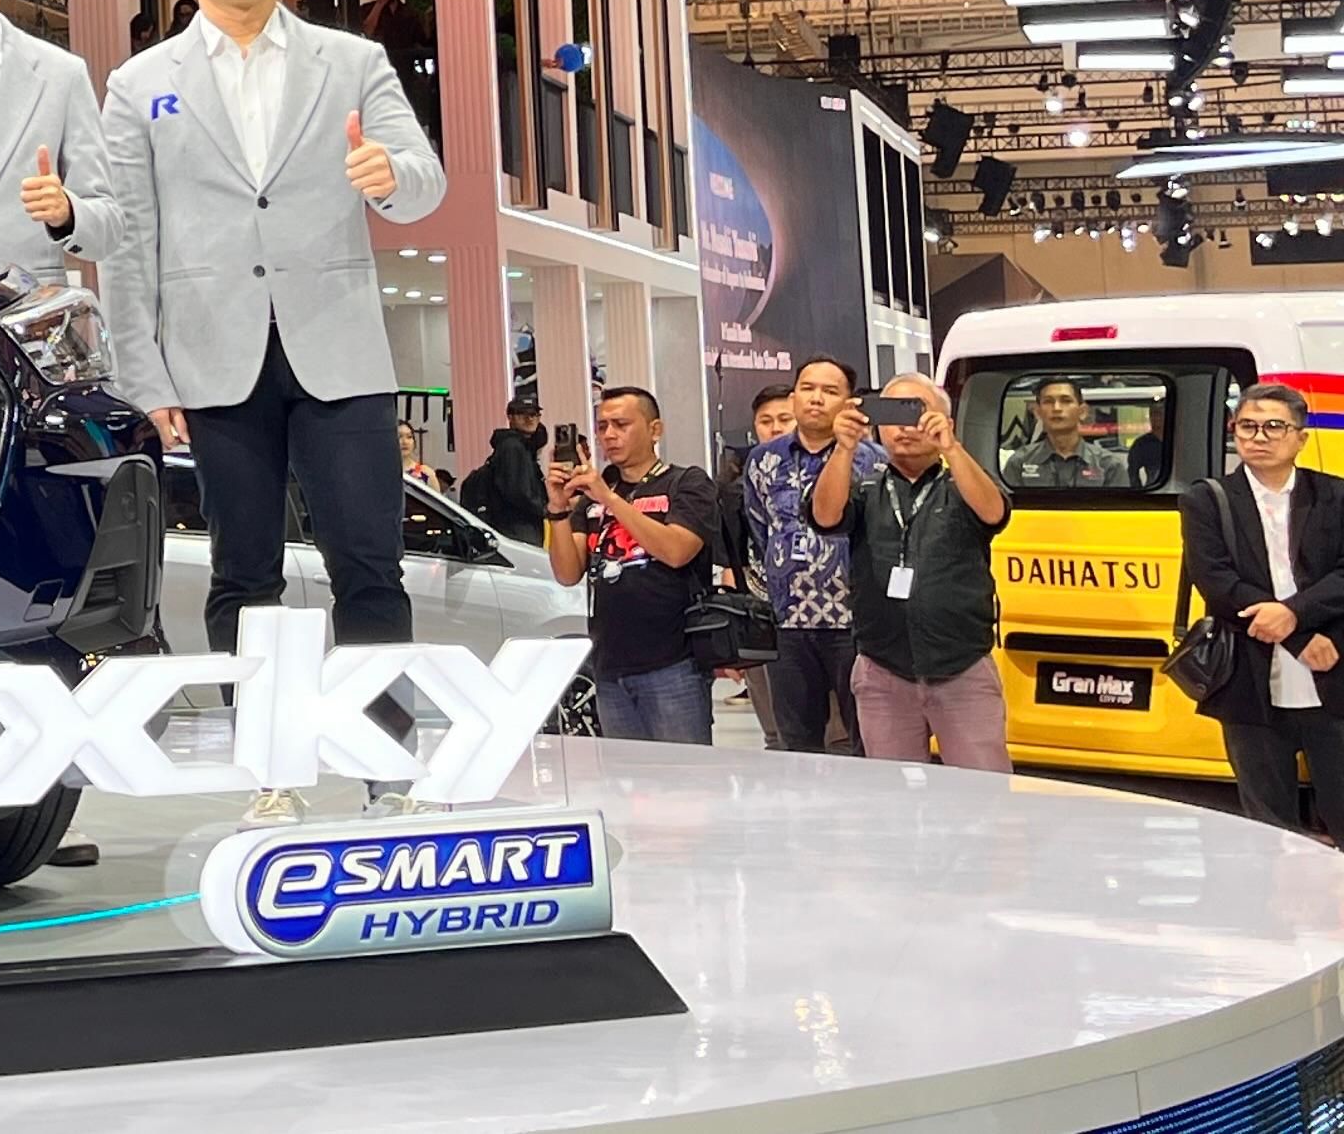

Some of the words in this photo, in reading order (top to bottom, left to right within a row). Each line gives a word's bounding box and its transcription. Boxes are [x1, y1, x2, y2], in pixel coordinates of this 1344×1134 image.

[150, 93, 181, 122] R
[1006, 556, 1161, 589] DAIHATSU
[1052, 671, 1095, 695] Gran
[1096, 674, 1135, 697] Max
[358, 898, 559, 942] HYBRID
